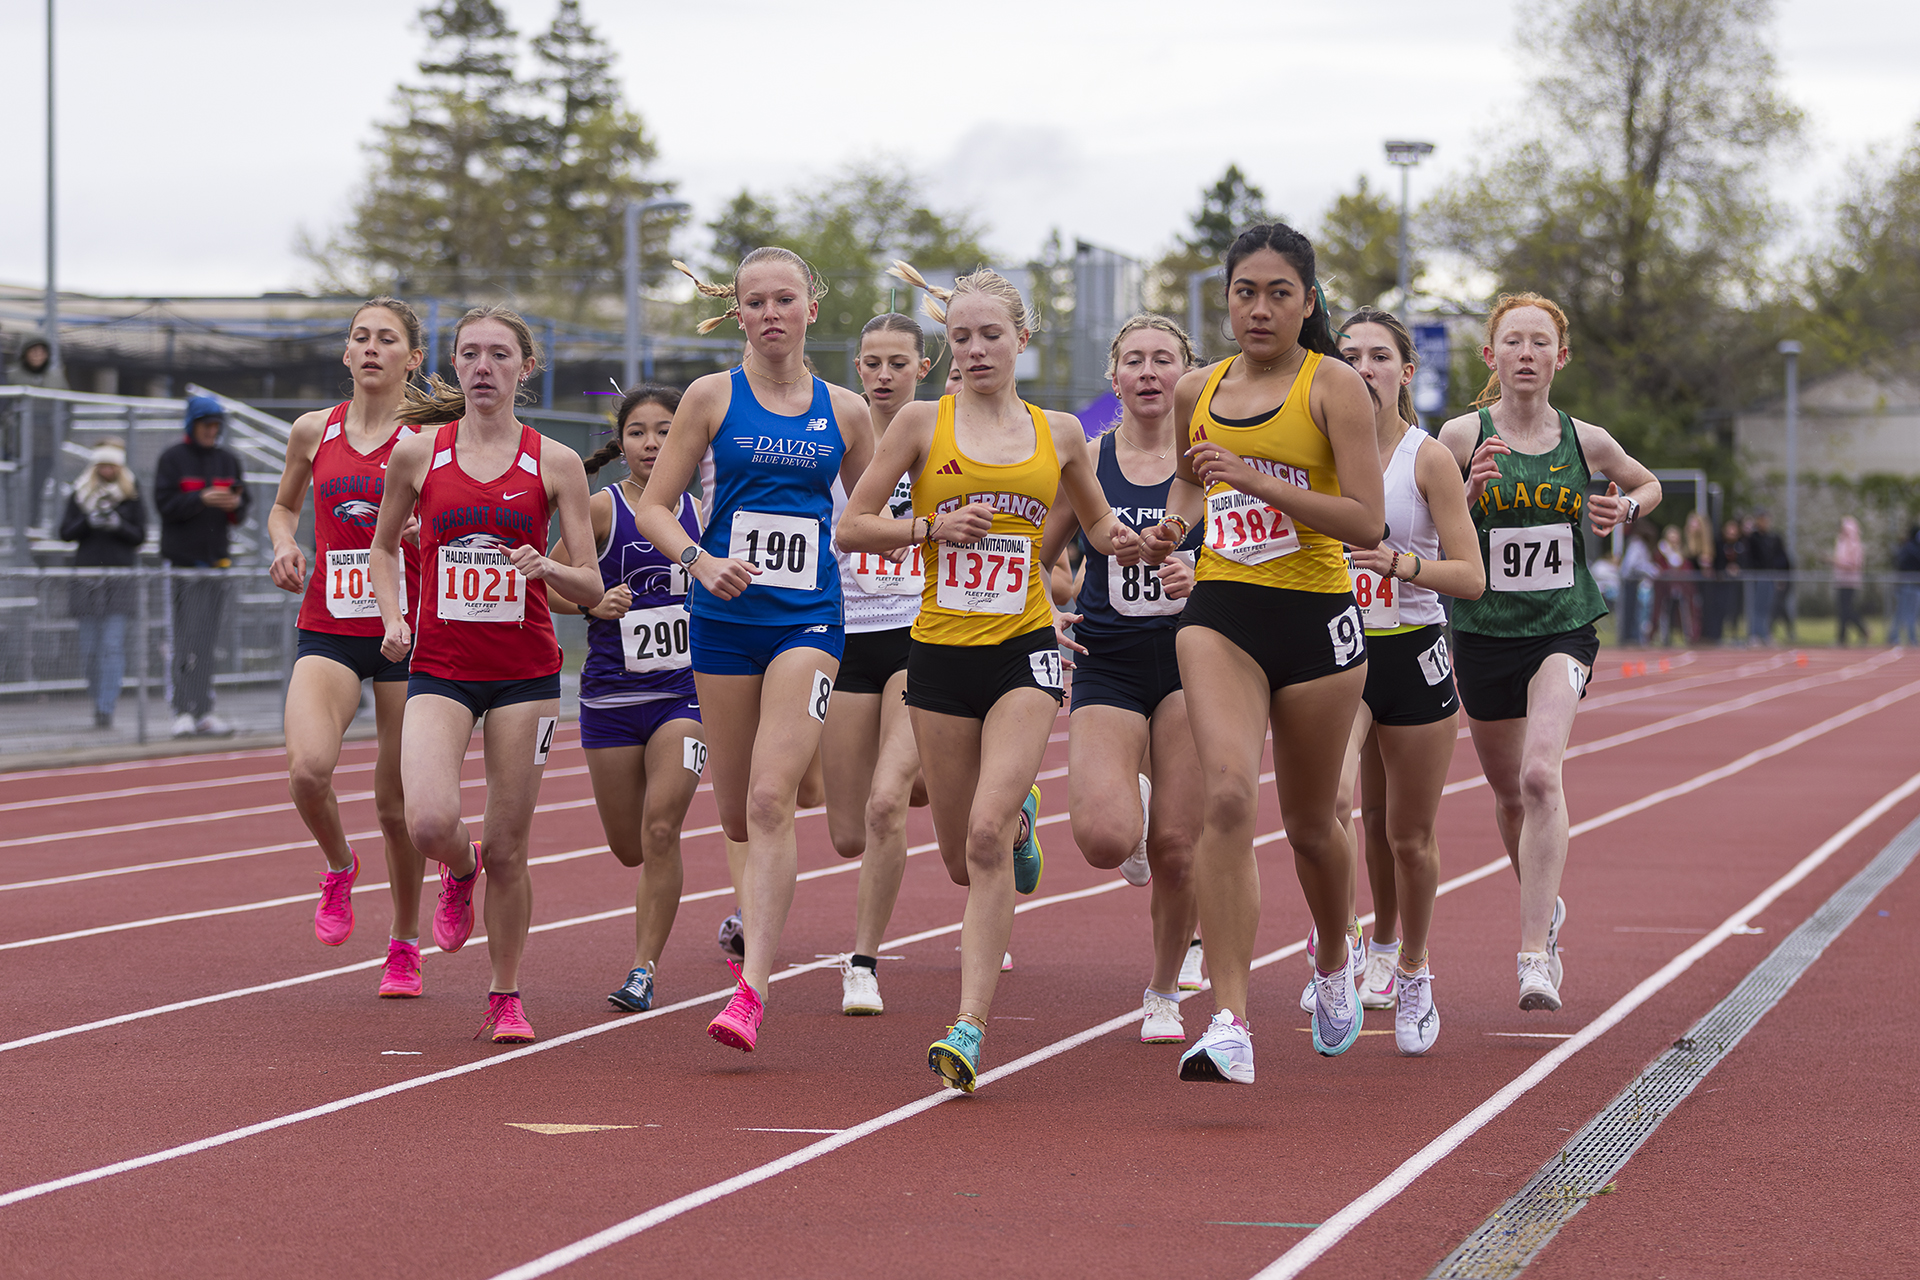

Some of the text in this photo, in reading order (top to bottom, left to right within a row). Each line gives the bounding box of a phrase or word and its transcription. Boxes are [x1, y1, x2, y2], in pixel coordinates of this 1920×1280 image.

[751, 454, 818, 469] BLUE DEVILS
[754, 436, 817, 457] DAVIS
[320, 475, 371, 501] PLEASANT
[1478, 482, 1583, 520] PLACER
[432, 505, 534, 536] PLEASANT GROVE
[966, 491, 1049, 529] FRANCIS
[1212, 505, 1290, 550] 1382
[331, 553, 355, 565] HALDEN
[445, 550, 472, 564] HALDEN
[746, 529, 807, 573] 190
[977, 537, 1025, 553] INVITATIONAL
[1251, 542, 1267, 550] FEET
[1503, 539, 1562, 577] 974
[445, 566, 518, 602] 1021
[945, 551, 1025, 593] 1375
[633, 618, 689, 660] 290
[1337, 615, 1358, 661] 9
[1040, 652, 1060, 686] 17
[1428, 640, 1450, 677] 18
[816, 677, 831, 721] 8
[540, 720, 555, 762] 4
[692, 741, 707, 775] 19
